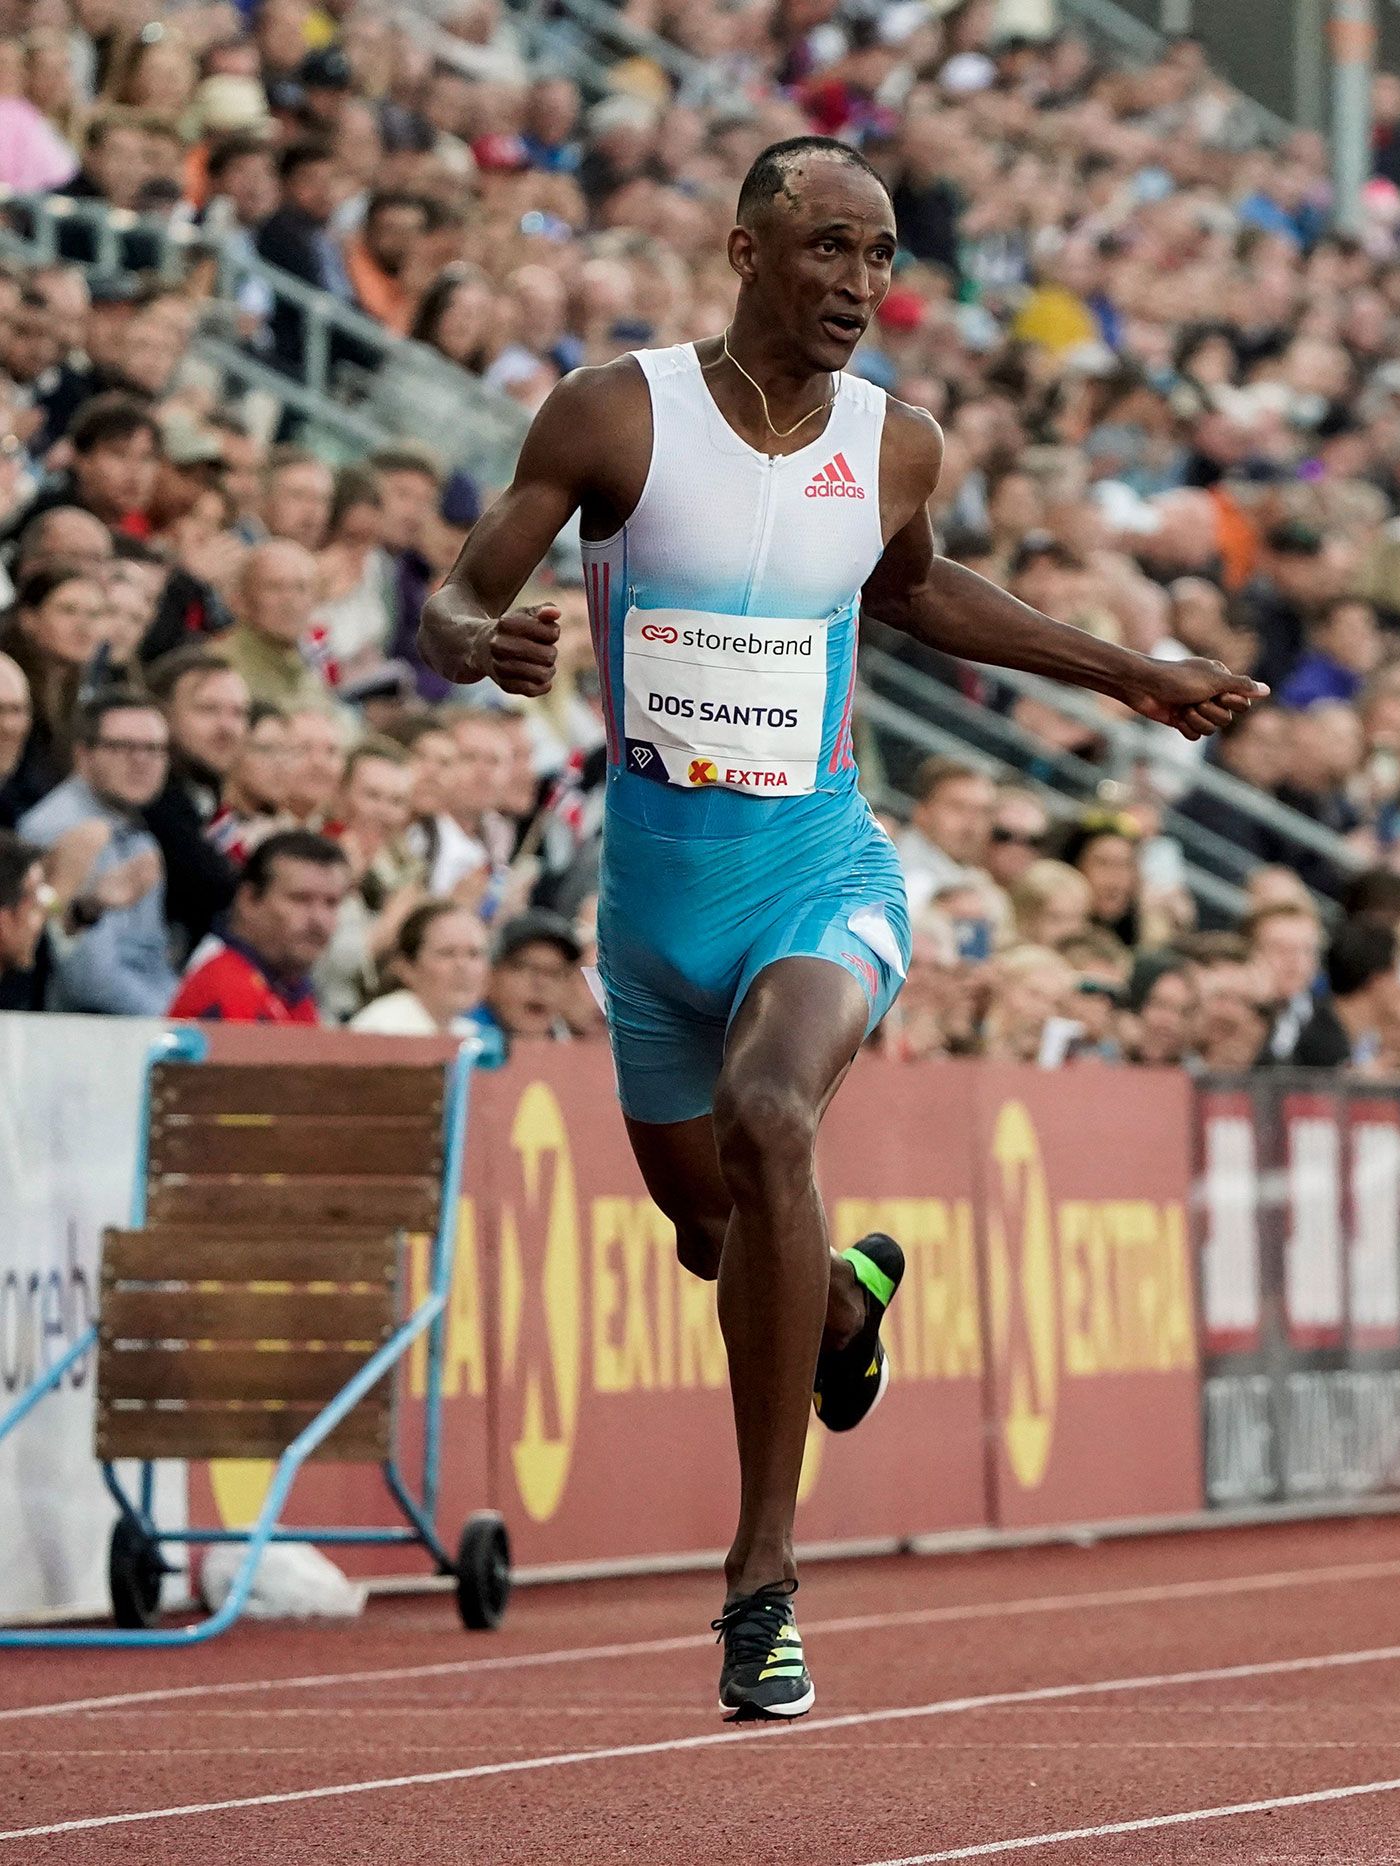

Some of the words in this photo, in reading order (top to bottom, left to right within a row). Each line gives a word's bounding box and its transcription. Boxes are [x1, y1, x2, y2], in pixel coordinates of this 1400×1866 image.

[804, 481, 865, 500] adidas
[682, 628, 812, 656] storebrand
[648, 692, 694, 718] DOS
[700, 701, 798, 728] SANTOS
[725, 769, 788, 787] EXTRA
